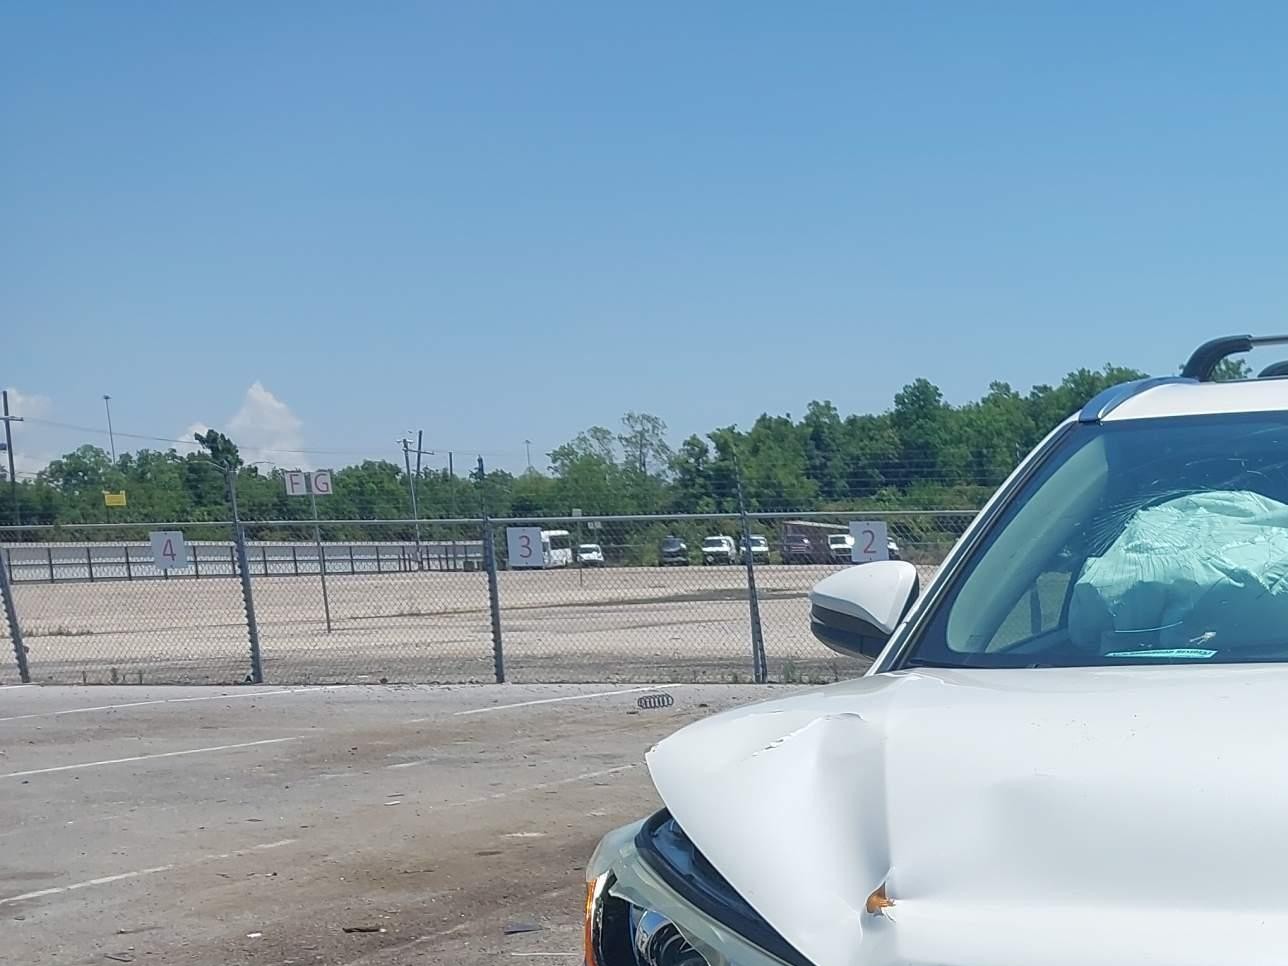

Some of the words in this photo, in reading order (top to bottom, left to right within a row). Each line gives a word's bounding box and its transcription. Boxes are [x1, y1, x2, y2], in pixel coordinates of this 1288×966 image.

[289, 473, 301, 494] F
[314, 473, 329, 493] G
[162, 539, 177, 561] 4
[518, 535, 532, 558] 3
[862, 530, 877, 554] 2
